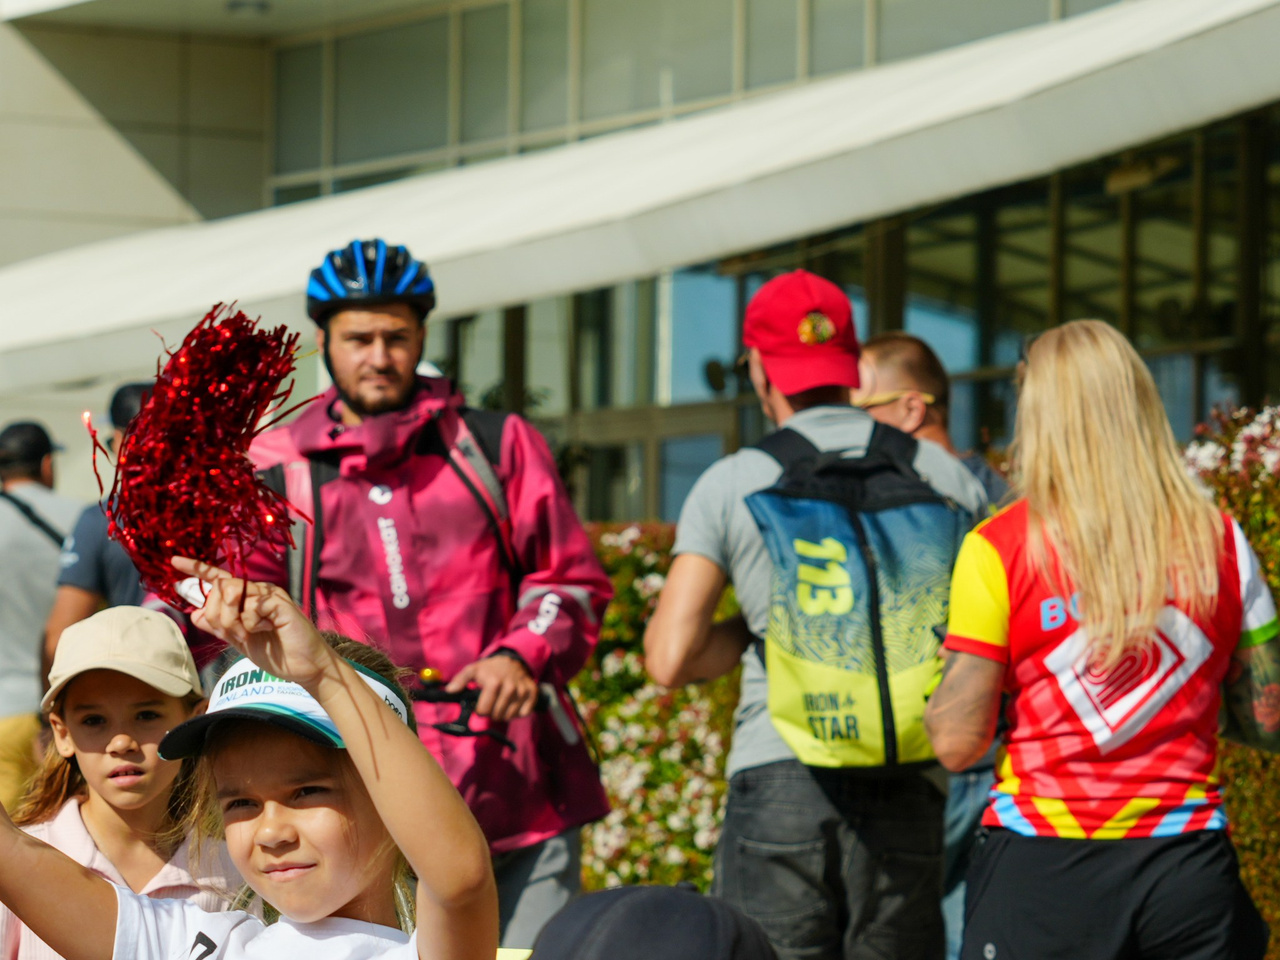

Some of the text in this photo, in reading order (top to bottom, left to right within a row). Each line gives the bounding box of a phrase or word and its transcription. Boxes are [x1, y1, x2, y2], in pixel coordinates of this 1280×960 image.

[792, 537, 854, 616] 113
[803, 692, 839, 711] IRON
[808, 715, 860, 741] STAR
